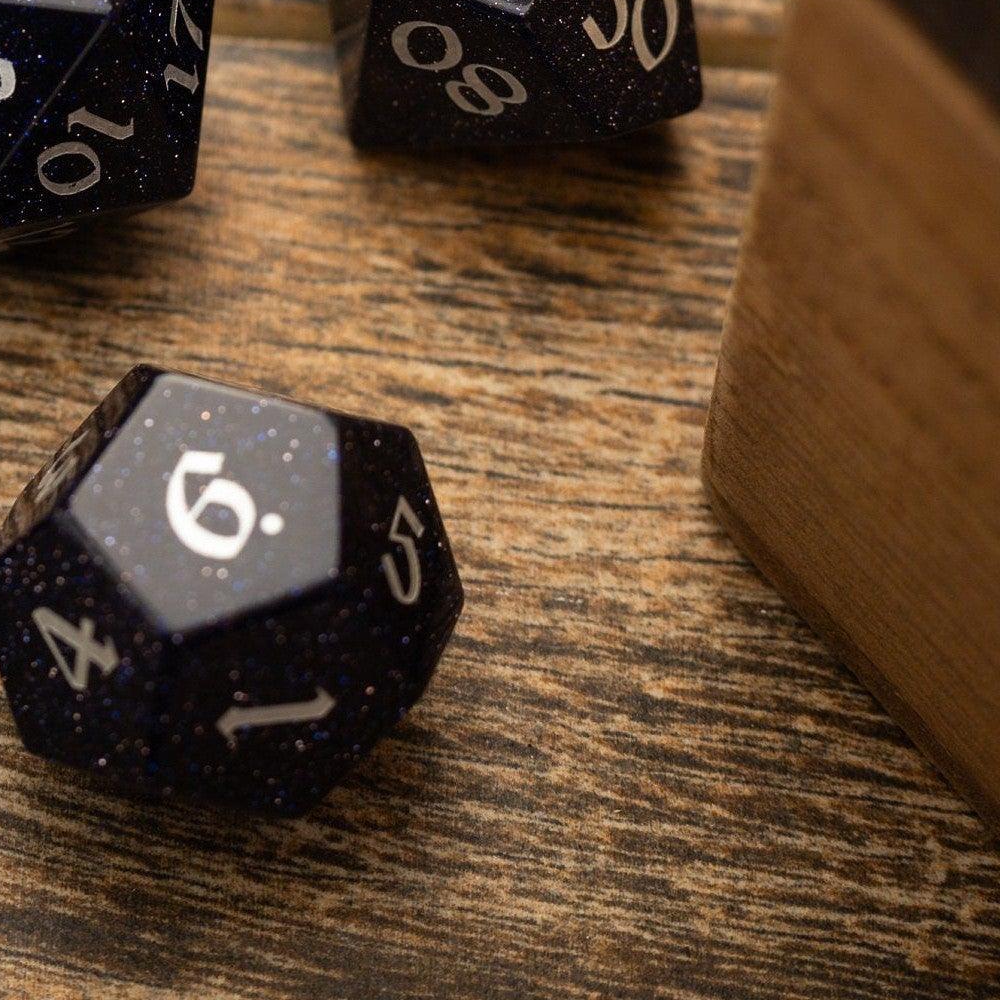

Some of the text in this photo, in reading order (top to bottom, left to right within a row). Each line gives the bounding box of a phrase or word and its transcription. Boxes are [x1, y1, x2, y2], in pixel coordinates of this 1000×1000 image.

[391, 21, 528, 116] 80
[37, 106, 134, 195] 10
[381, 495, 424, 604] 5
[32, 606, 119, 690] 4
